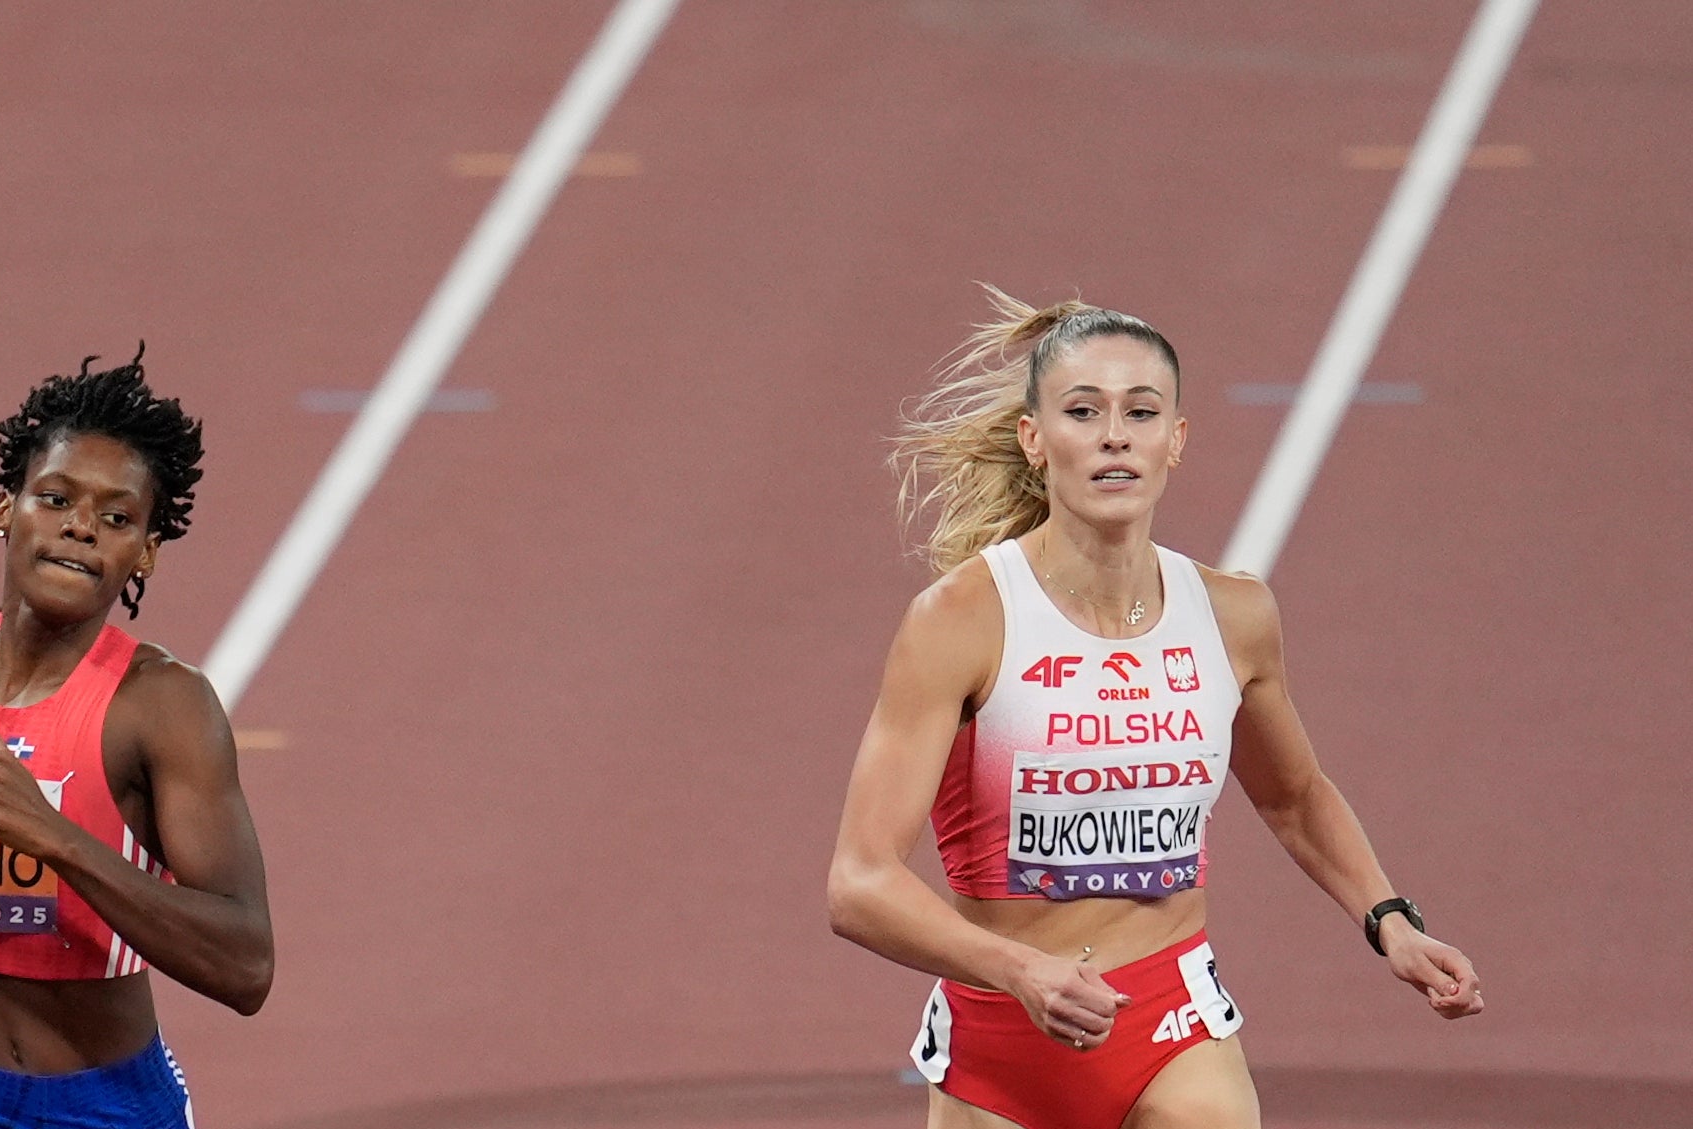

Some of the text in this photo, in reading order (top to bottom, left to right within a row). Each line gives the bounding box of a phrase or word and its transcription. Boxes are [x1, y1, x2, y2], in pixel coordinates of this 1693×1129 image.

[1020, 655, 1084, 688] 4F
[1097, 687, 1150, 702] ORLEN
[1045, 709, 1204, 746] POLSKA
[1017, 759, 1213, 795] HONDA
[1018, 804, 1201, 856] BUKOWIECKA
